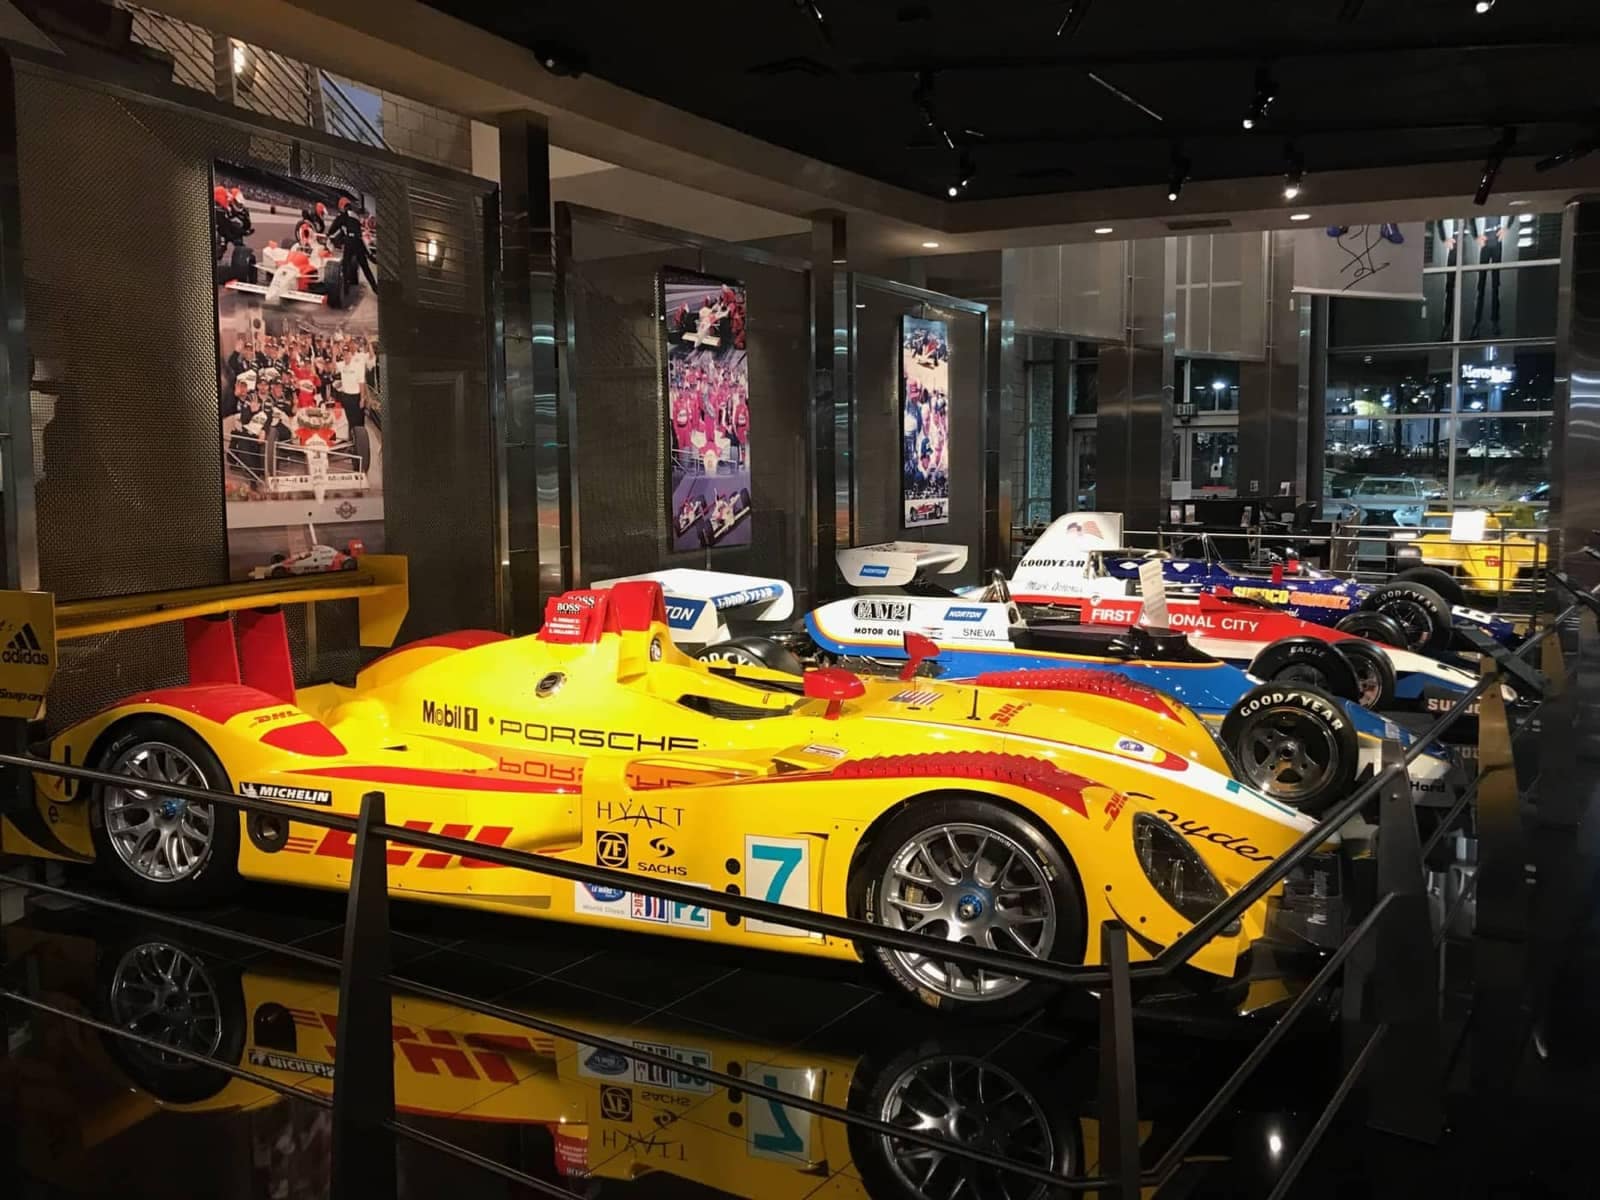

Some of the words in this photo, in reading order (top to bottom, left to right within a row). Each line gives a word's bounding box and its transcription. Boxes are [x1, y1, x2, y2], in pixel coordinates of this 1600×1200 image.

[1020, 559, 1085, 568] GOODYEAR
[556, 603, 580, 612] BOSS
[664, 605, 695, 621] TON
[853, 600, 905, 621] CAM2
[948, 610, 982, 619] NORTON
[1092, 608, 1134, 622] FIRST
[1221, 617, 1259, 632] CITY
[854, 627, 883, 635] MOTOR
[887, 628, 901, 636] OIL
[962, 628, 996, 637] SNEVA
[2, 649, 49, 665] adidas
[254, 710, 293, 723] DHL
[423, 700, 461, 730] Mobil
[464, 707, 478, 732] 1
[500, 719, 699, 751] PORSCHE
[260, 786, 329, 803] MICHELIN
[1409, 781, 1446, 792] Hard
[597, 800, 685, 829] HYATT
[599, 838, 626, 861] ZF
[637, 861, 687, 876] SACHS
[752, 844, 802, 905] 7
